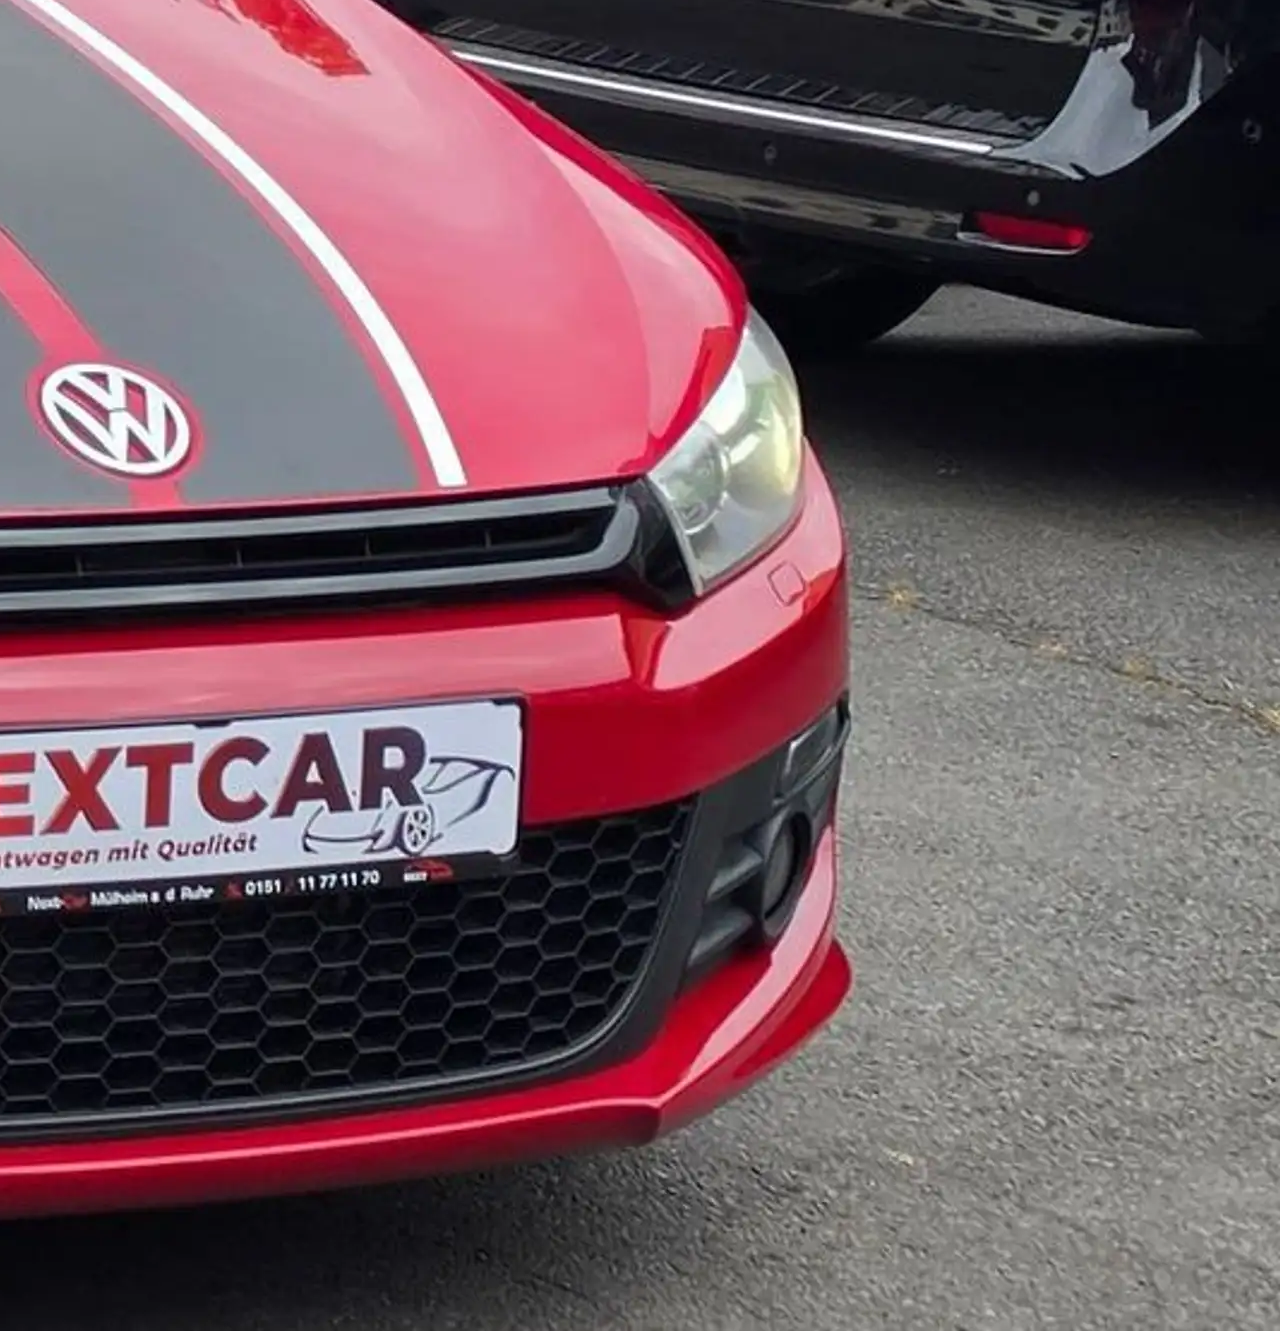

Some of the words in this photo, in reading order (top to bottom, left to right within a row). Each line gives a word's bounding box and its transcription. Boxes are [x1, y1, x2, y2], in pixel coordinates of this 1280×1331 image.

[107, 839, 149, 862] mit
[157, 832, 257, 861] Qualität
[245, 878, 282, 897] 0151
